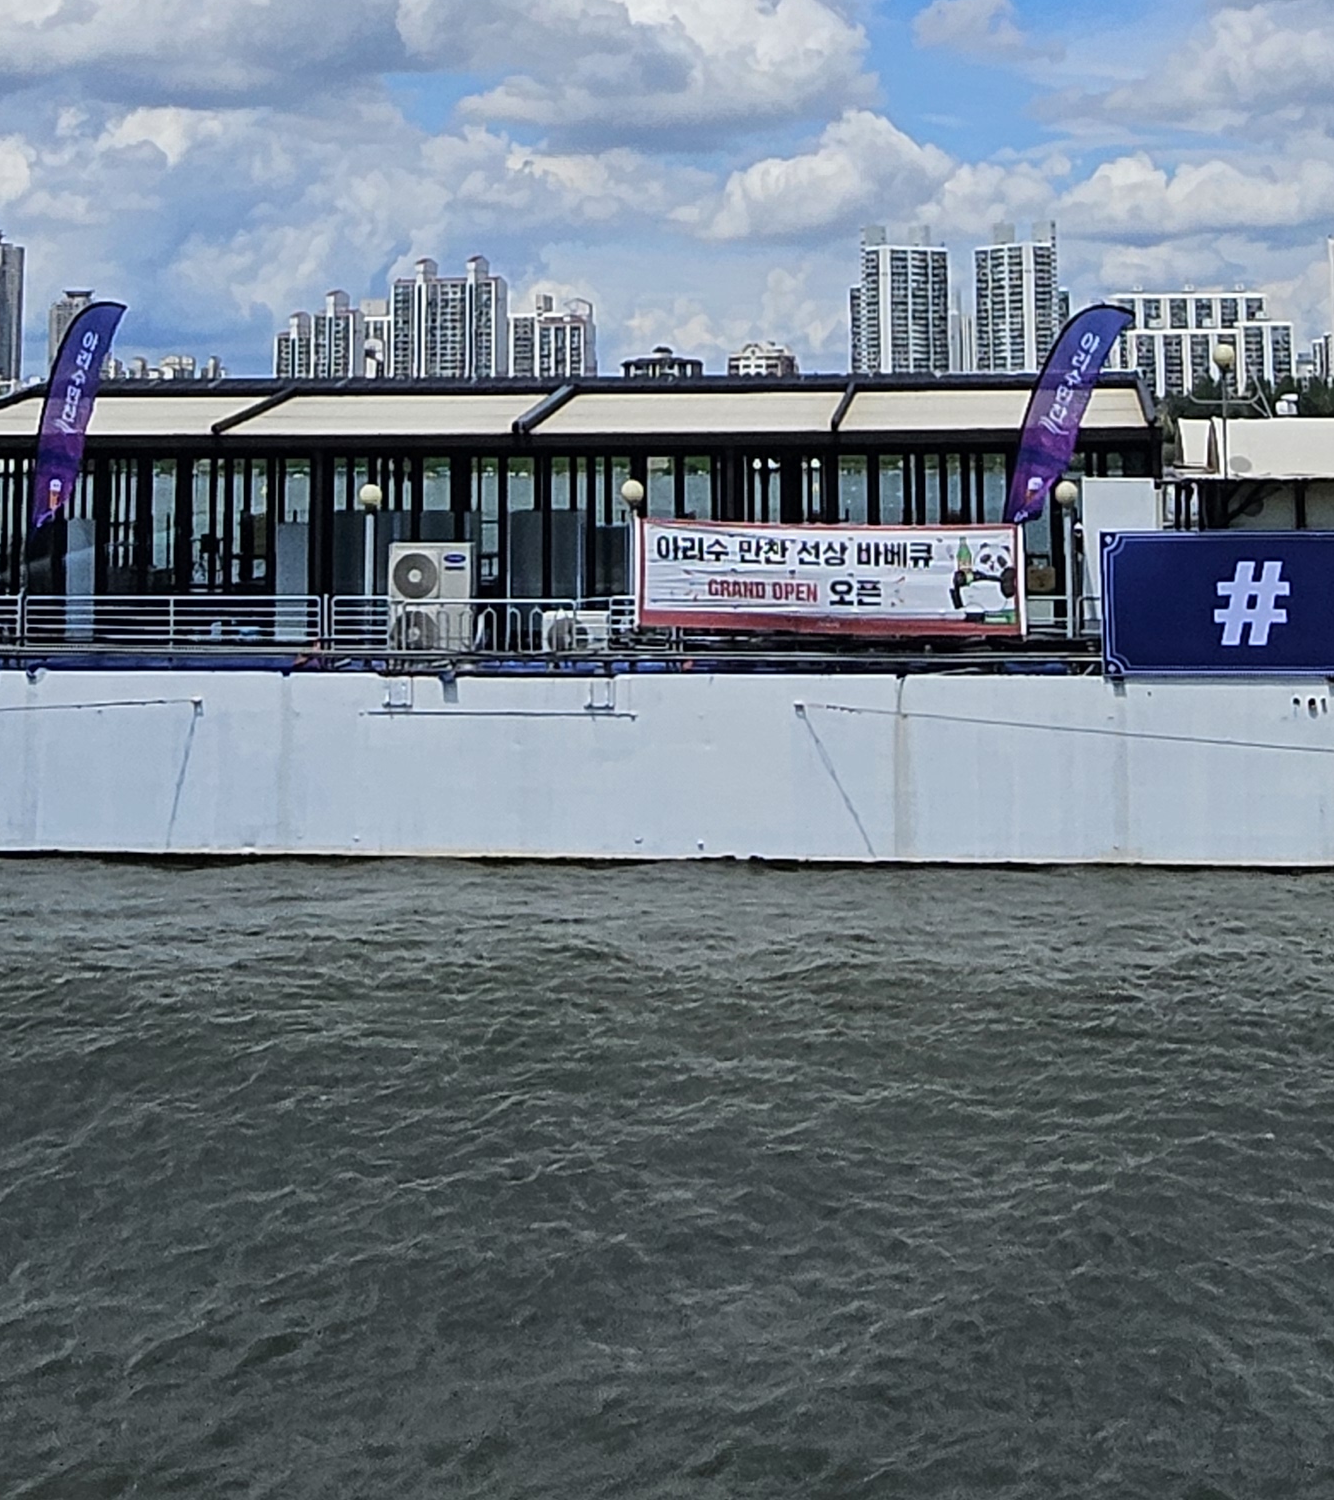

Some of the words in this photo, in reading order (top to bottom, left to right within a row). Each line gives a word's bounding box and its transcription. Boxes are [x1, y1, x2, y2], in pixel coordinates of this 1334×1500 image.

[657, 535, 729, 562] 아리수
[738, 538, 789, 565] 만찬
[797, 540, 848, 567] 선상
[856, 541, 934, 568] 바베큐
[708, 578, 766, 600] GRAND
[772, 581, 818, 603] OPEN
[830, 580, 882, 606] 오픈
